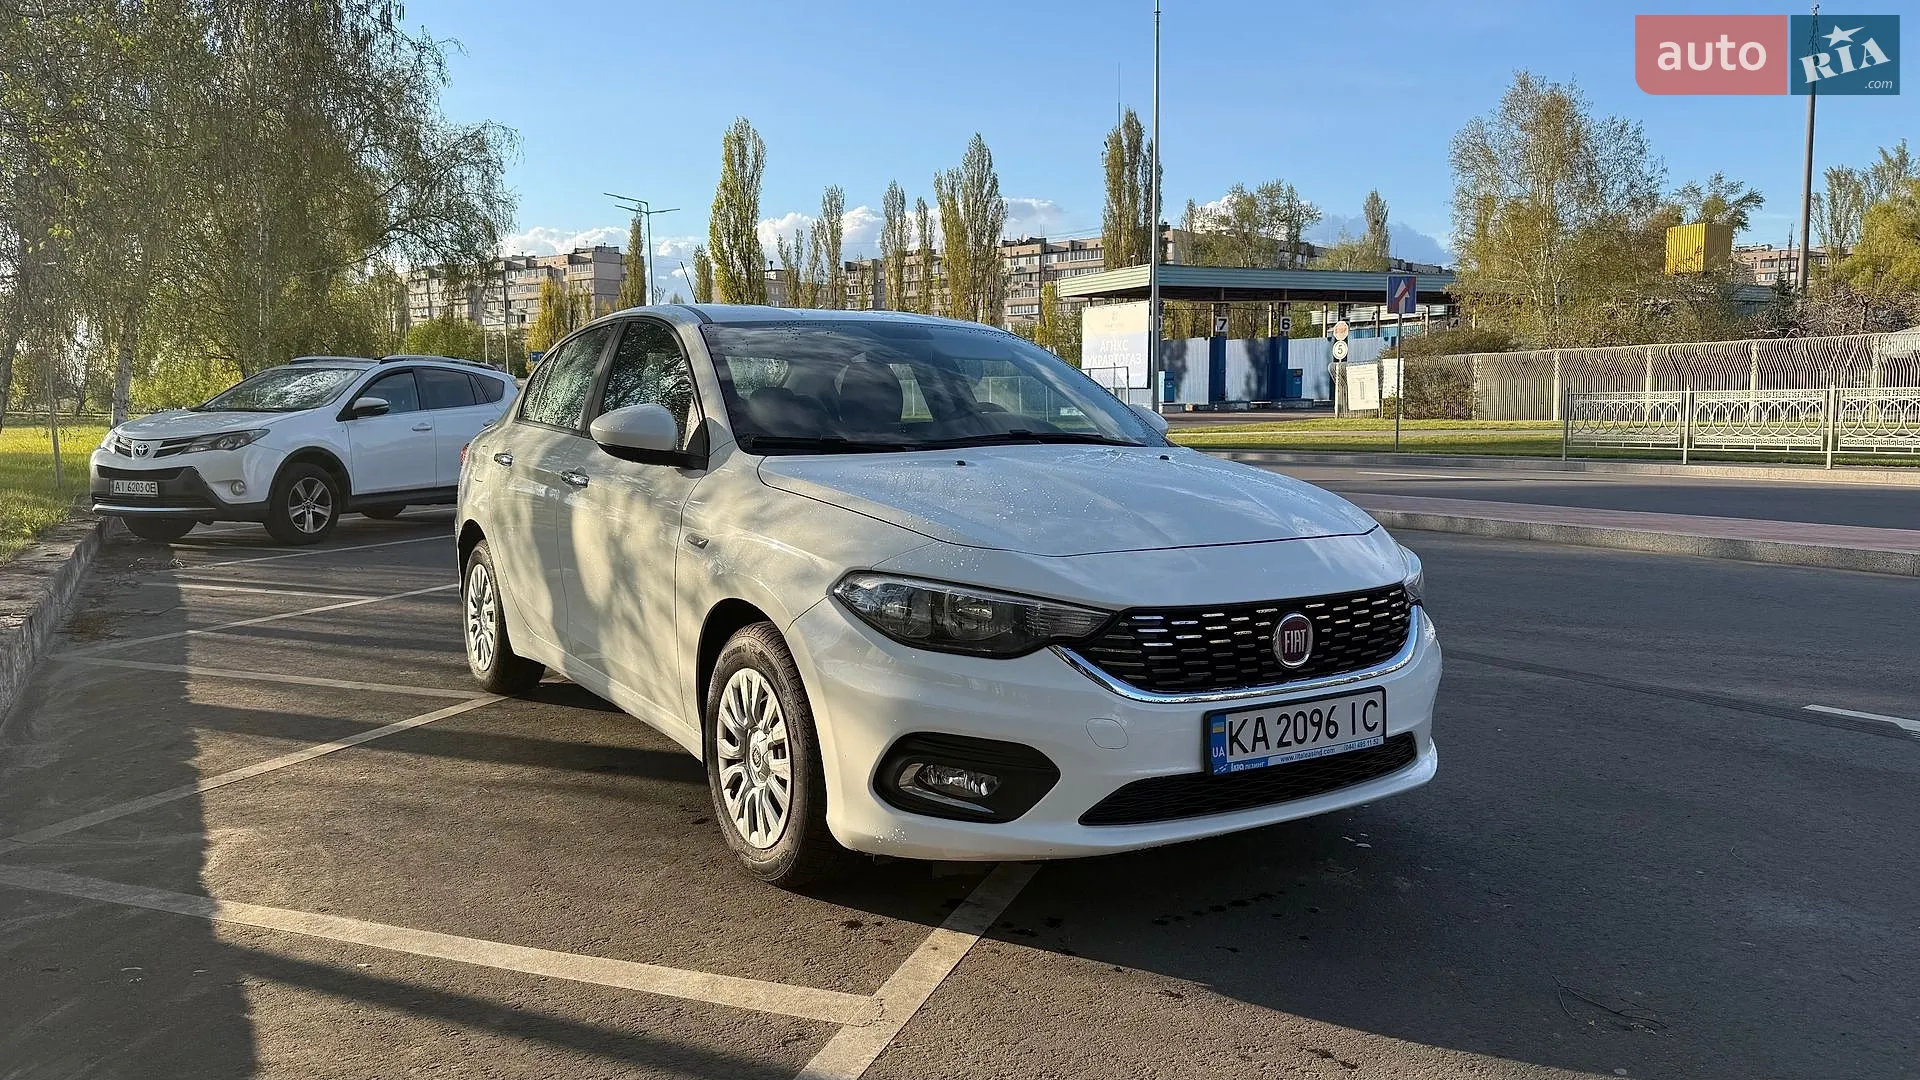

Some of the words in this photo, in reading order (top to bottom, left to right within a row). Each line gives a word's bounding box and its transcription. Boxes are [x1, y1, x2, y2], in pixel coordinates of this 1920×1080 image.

[1218, 318, 1228, 331] 7
[1281, 318, 1291, 330] 6
[1337, 344, 1343, 355] 5
[127, 482, 144, 493] 6203
[1284, 629, 1307, 654] FIAT
[1228, 716, 1271, 757] KA
[1276, 705, 1339, 749] 2096
[1351, 699, 1379, 736] IC
[1212, 746, 1226, 758] UA
